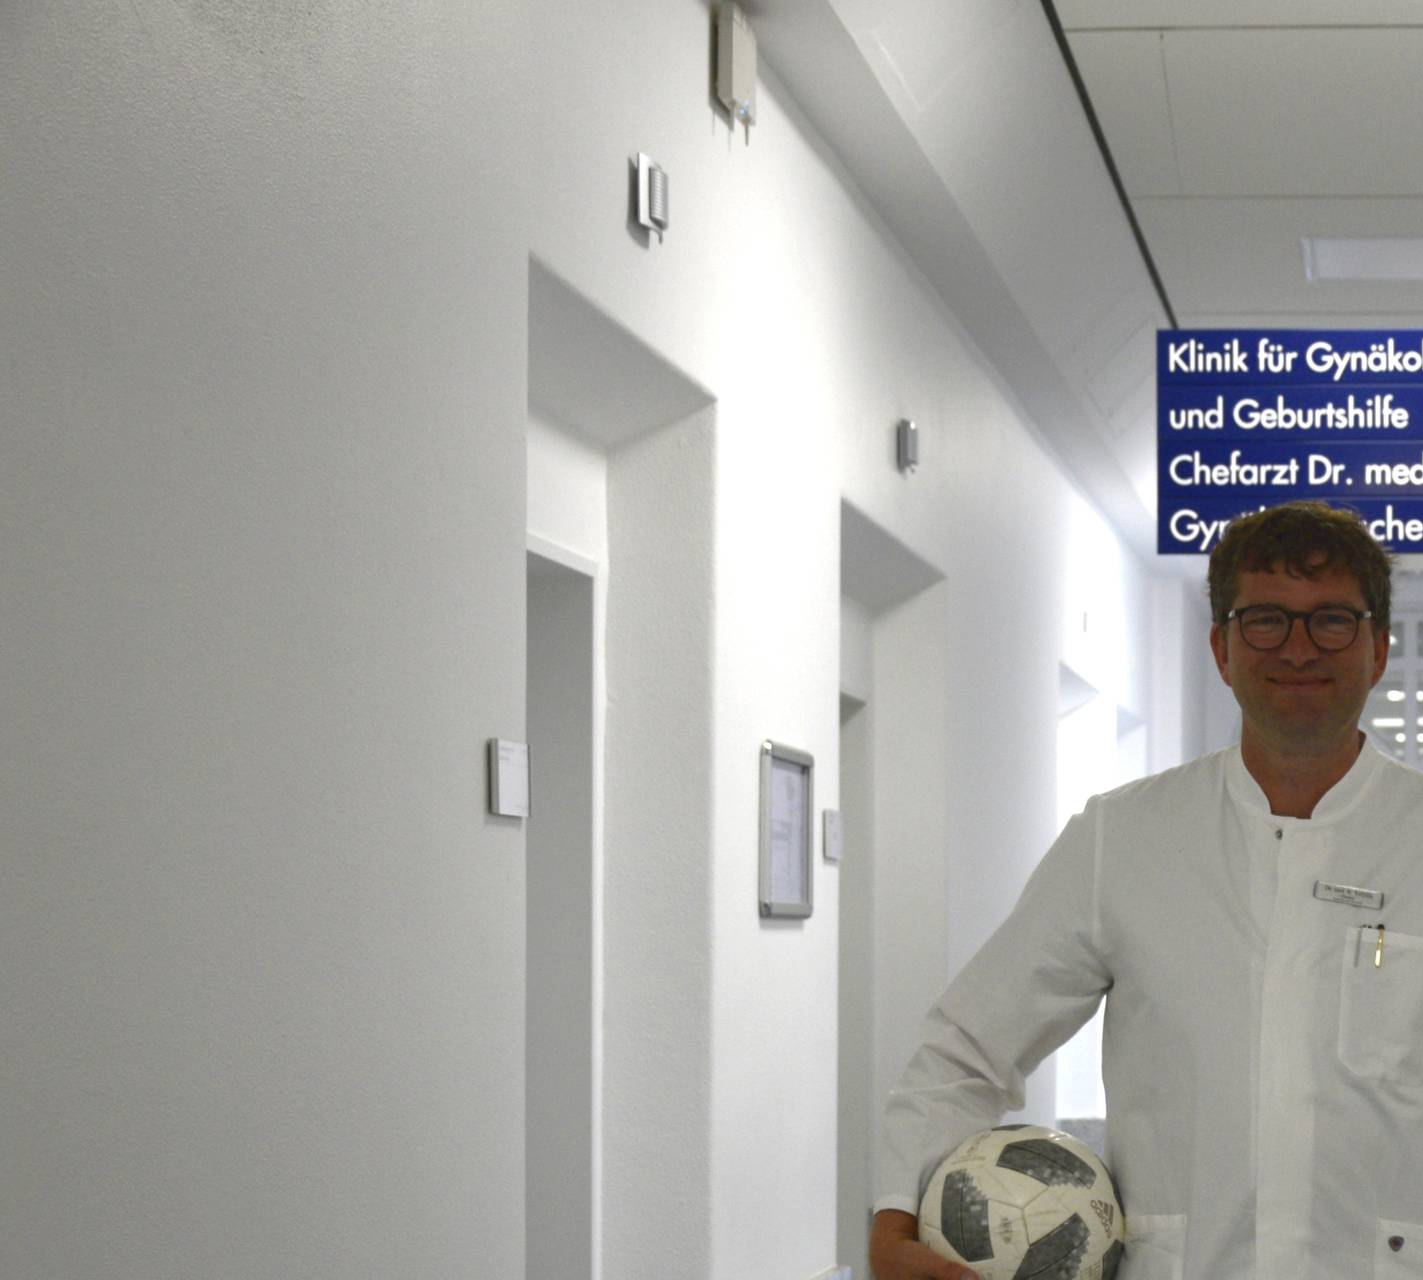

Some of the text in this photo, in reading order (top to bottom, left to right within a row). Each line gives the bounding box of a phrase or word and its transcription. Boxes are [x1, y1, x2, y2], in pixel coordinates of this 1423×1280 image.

[1168, 338, 1249, 373] Klinik
[1257, 337, 1299, 373] für
[1169, 394, 1410, 430] und Geburtshilfe
[1169, 450, 1300, 486] Chefarzt
[1308, 454, 1353, 486] Dr.
